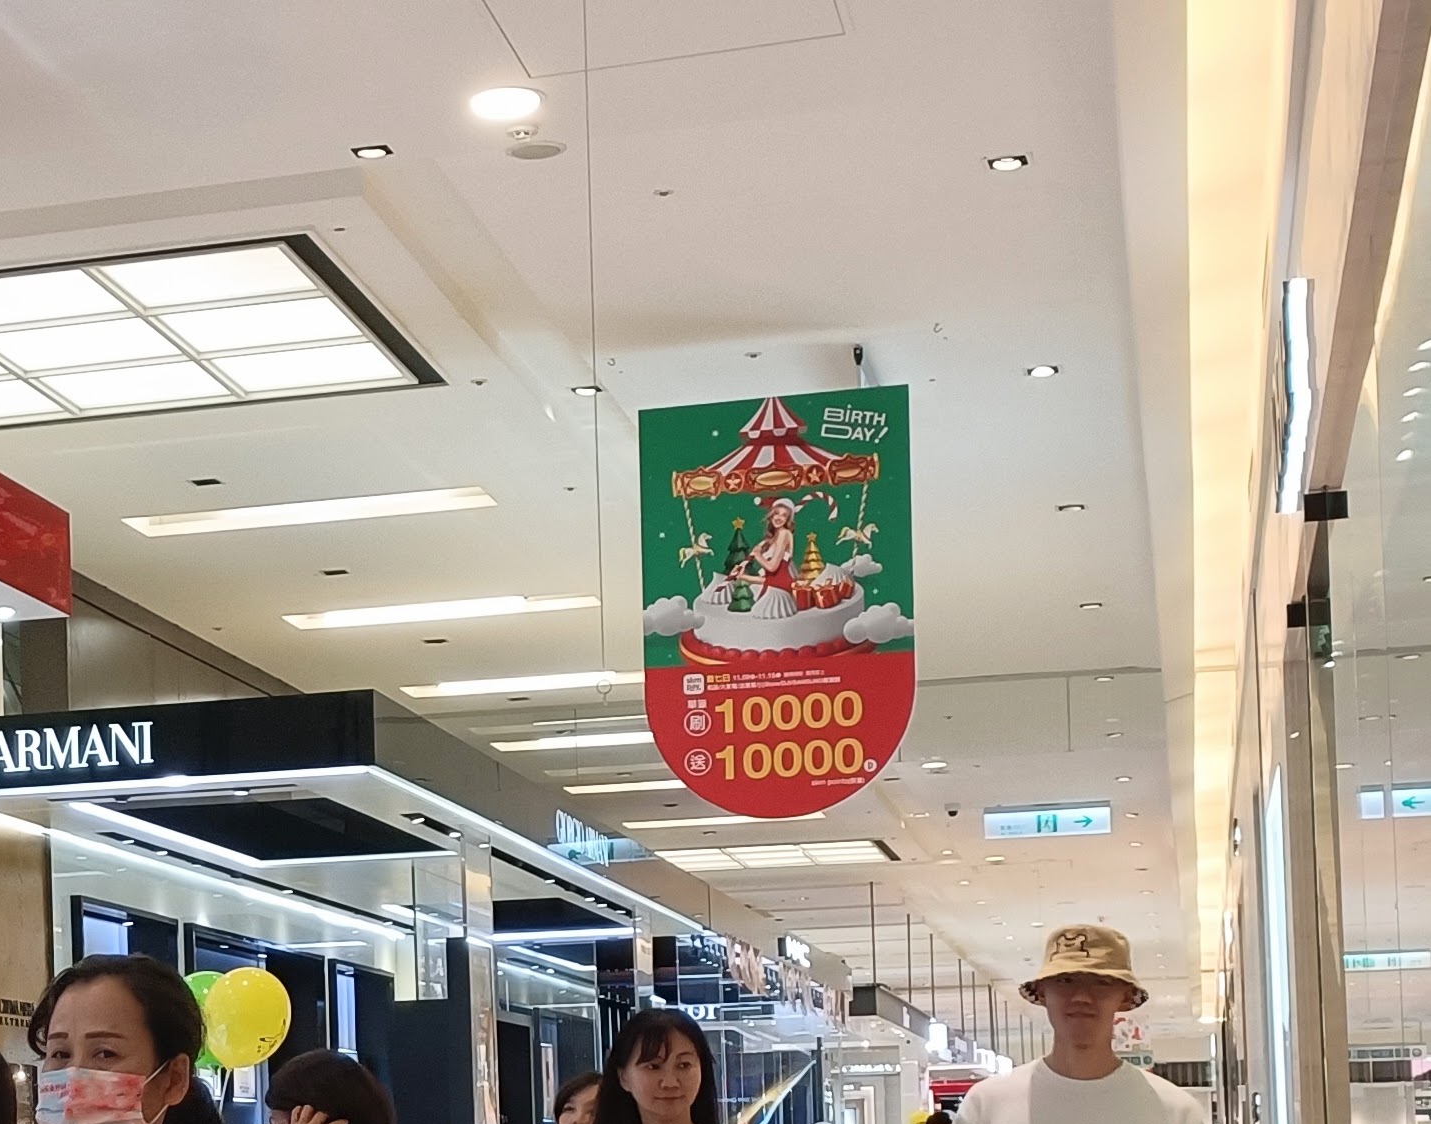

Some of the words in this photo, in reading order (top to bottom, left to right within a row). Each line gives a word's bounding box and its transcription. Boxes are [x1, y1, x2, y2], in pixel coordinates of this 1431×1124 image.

[820, 423, 889, 444] DAY!
[715, 690, 863, 734] 10000
[715, 737, 864, 780] 10000
